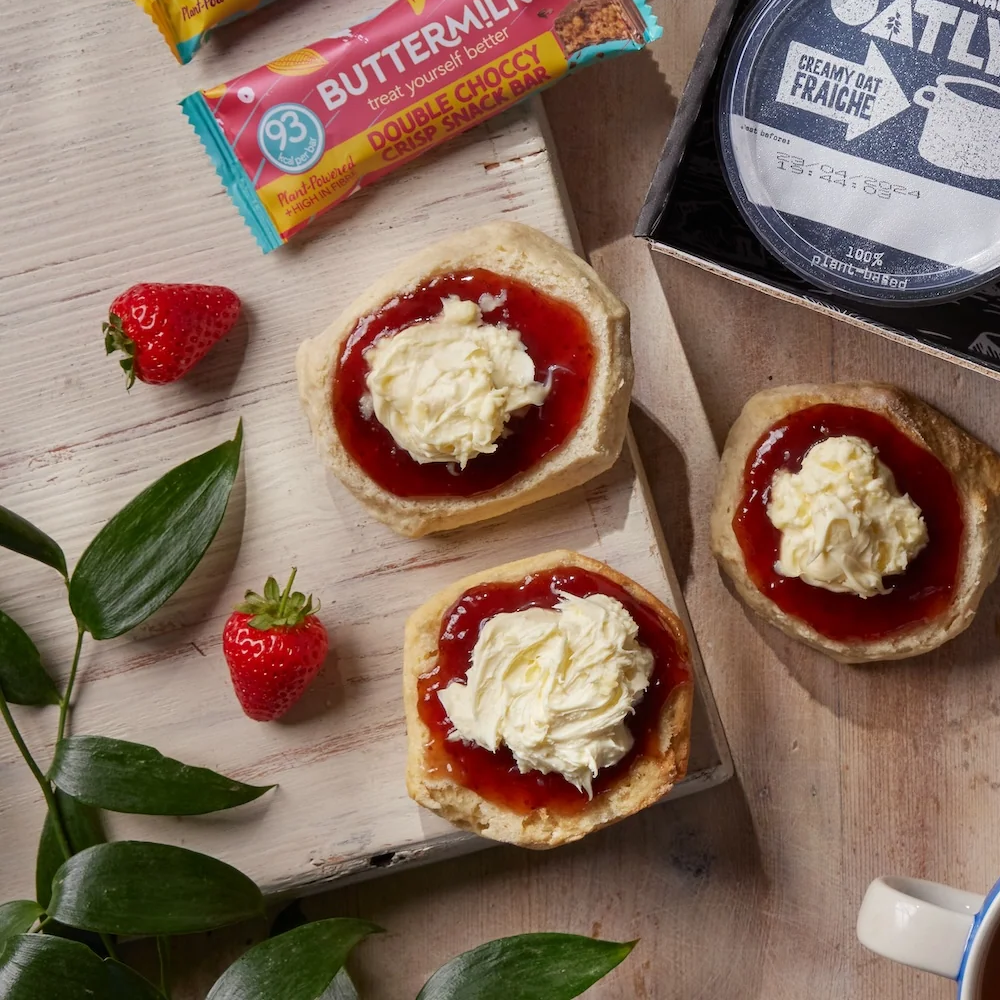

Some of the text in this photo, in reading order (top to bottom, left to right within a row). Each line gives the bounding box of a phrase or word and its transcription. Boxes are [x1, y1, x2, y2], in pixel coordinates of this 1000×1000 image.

[367, 26, 510, 111] treat yourself better
[799, 53, 883, 95] CREAMY OAT
[367, 44, 541, 152] DOUBLE CHOCCY
[381, 66, 551, 162] CRISP SNACK BAR
[790, 71, 877, 121] FRAICHE
[265, 111, 307, 151] 93
[278, 137, 317, 166] kcal per bar
[277, 155, 356, 207] Plant-Powered
[319, 187, 331, 198] IN
[811, 254, 908, 290] plant-based
[846, 246, 884, 267] 100%
